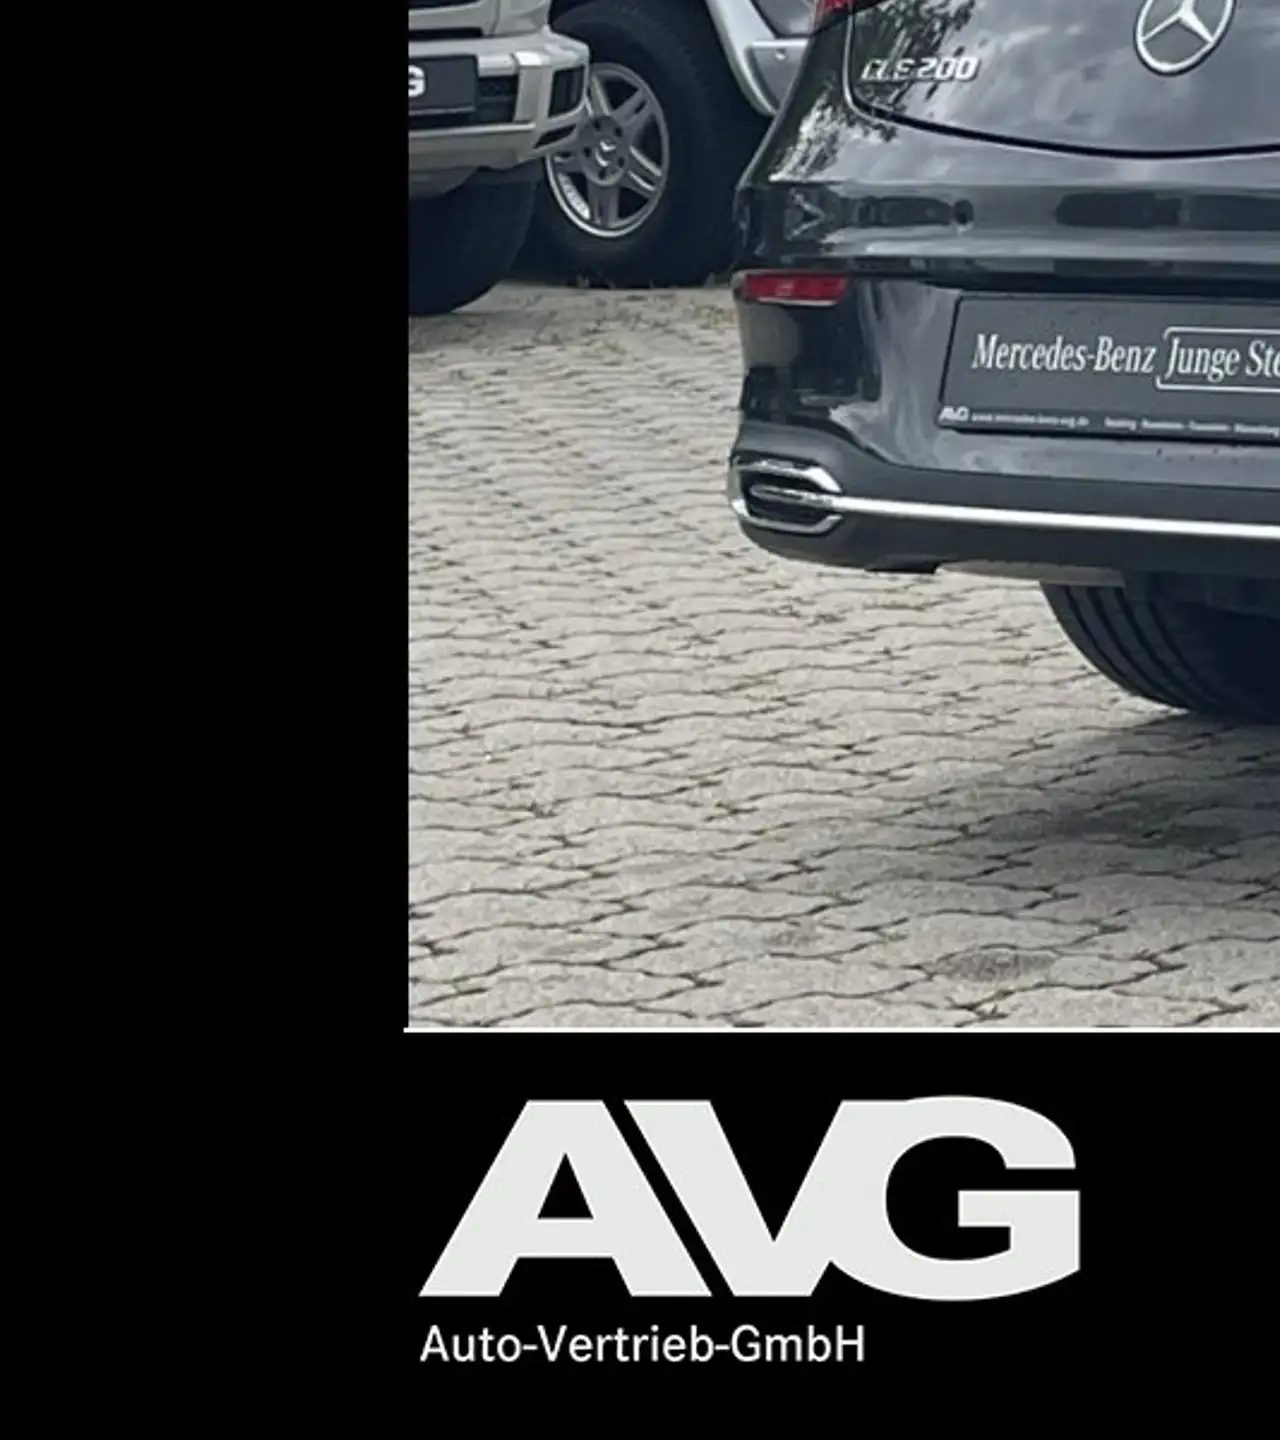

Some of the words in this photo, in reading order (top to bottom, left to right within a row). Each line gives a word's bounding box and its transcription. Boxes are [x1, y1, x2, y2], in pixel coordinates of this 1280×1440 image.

[916, 57, 979, 80] 200
[971, 333, 1155, 375] Mercedes-Benz
[1164, 336, 1240, 382] Junge
